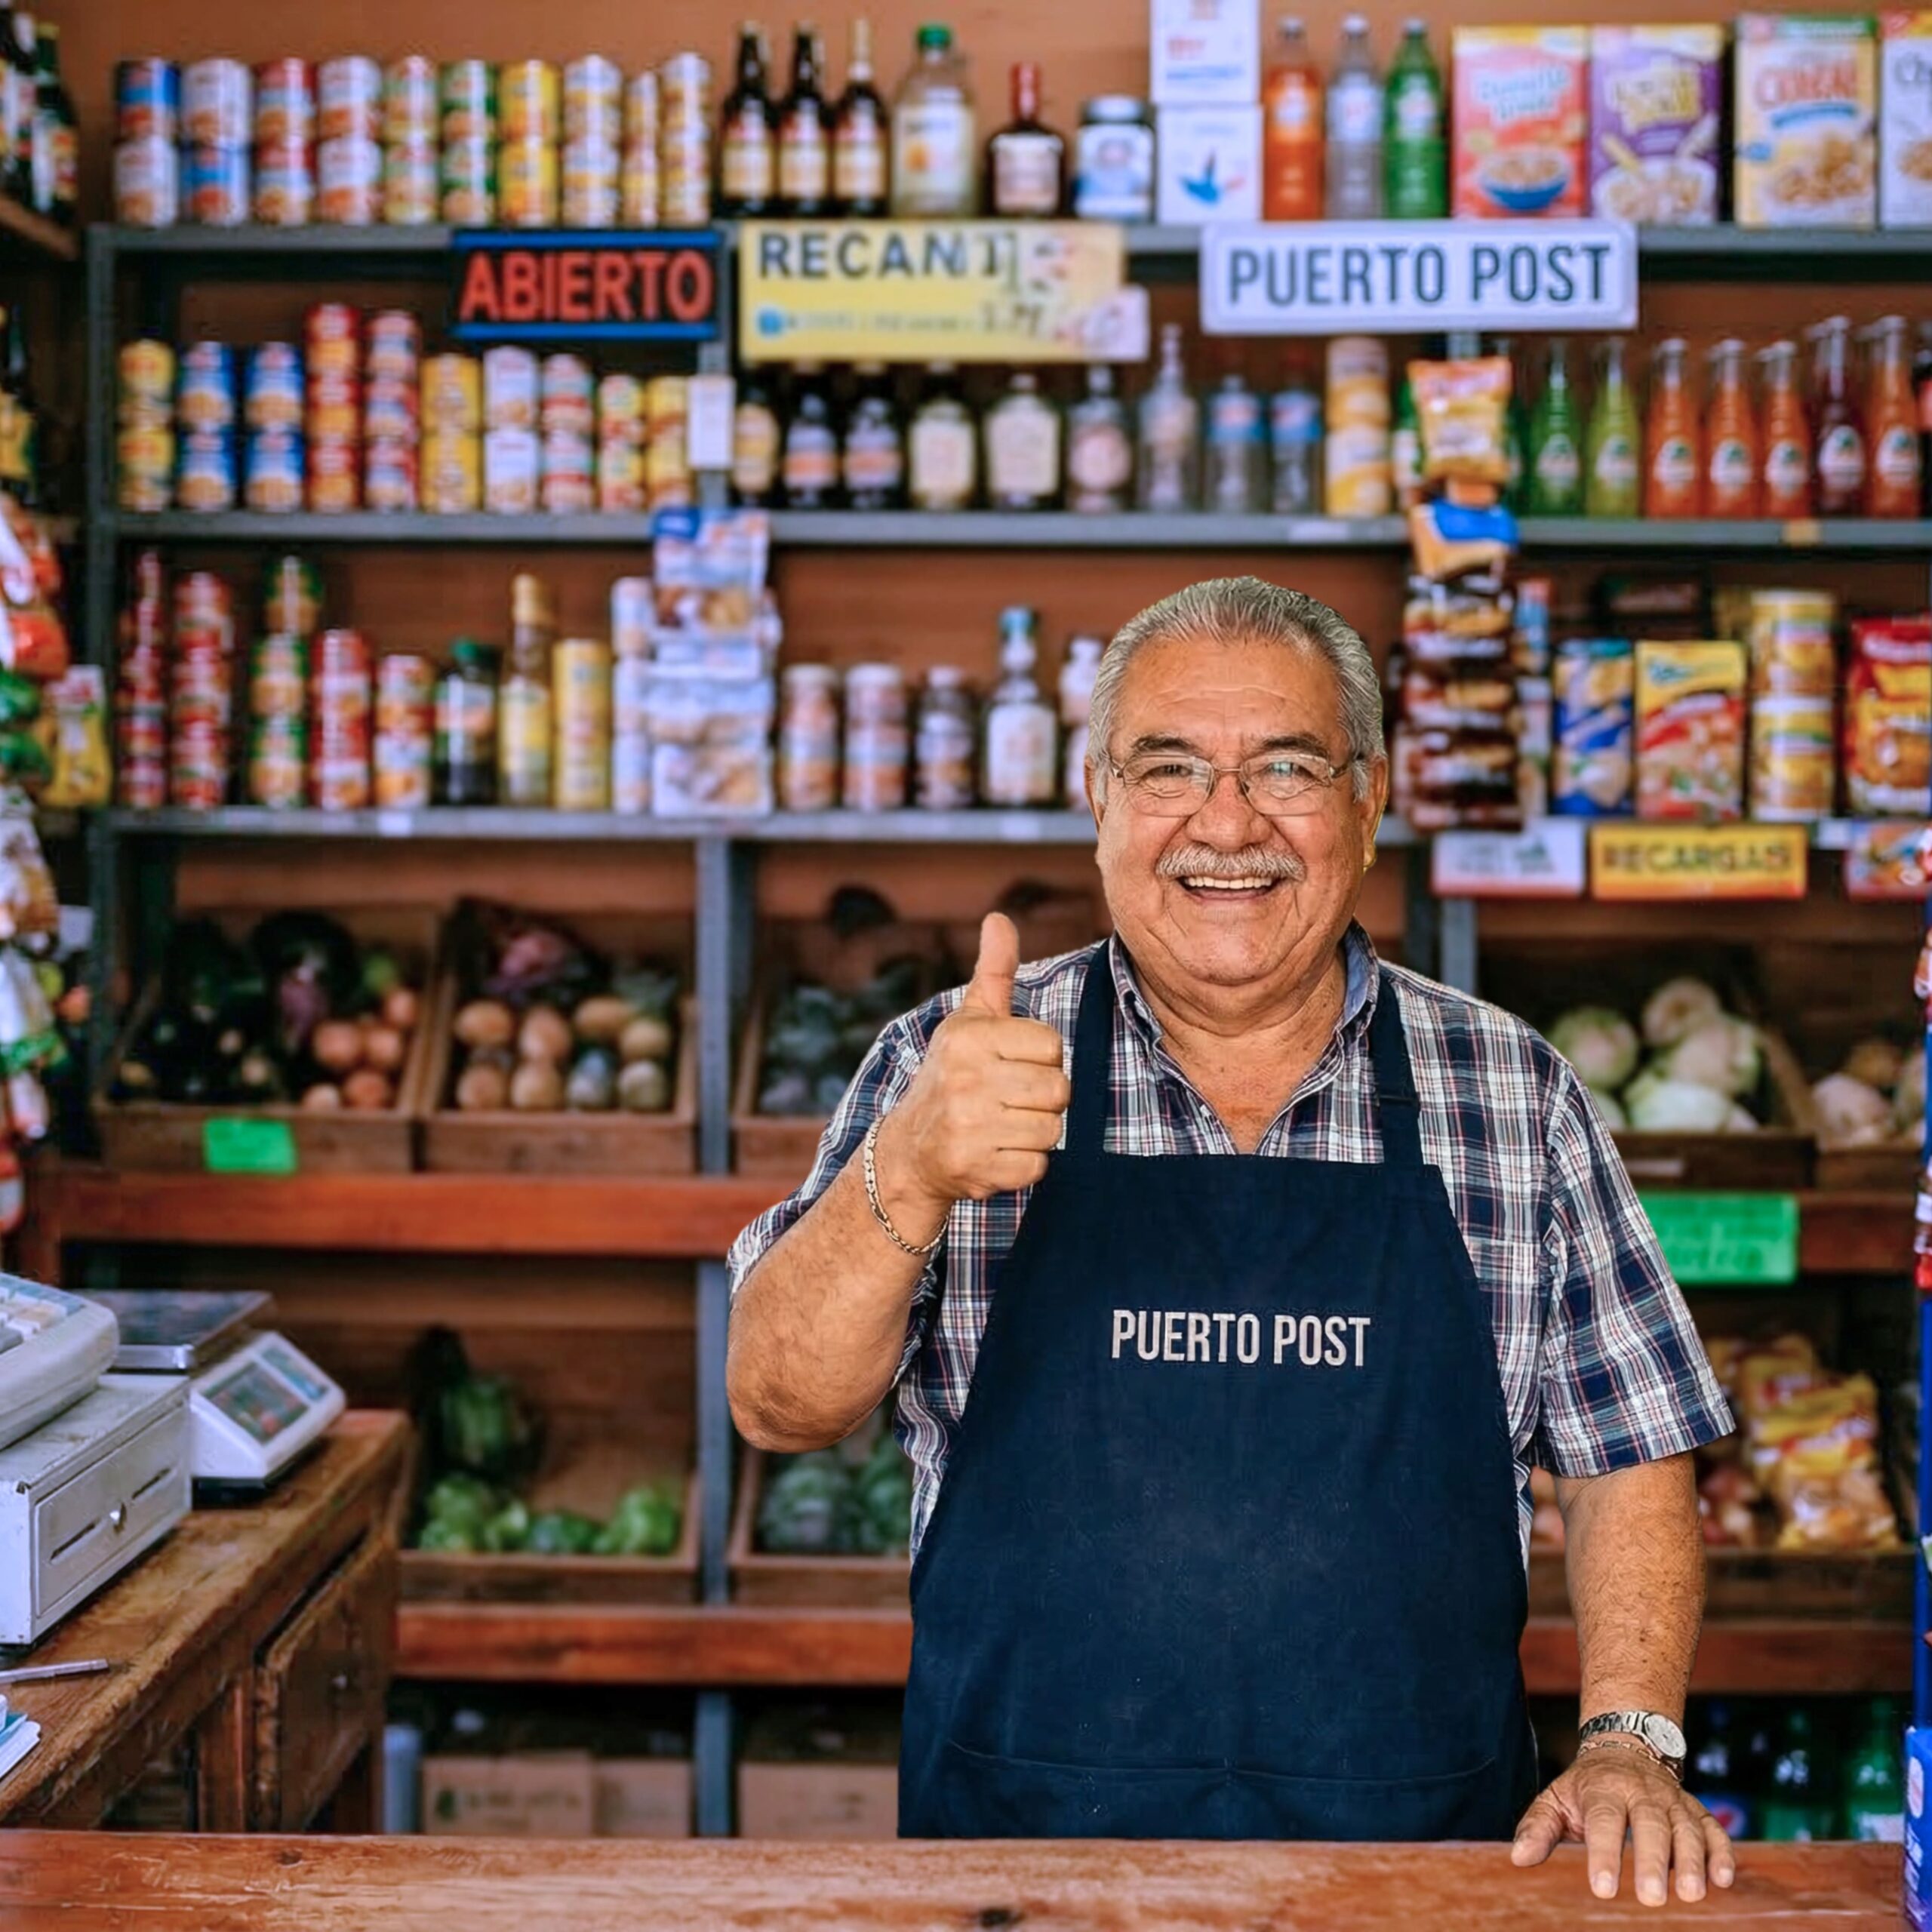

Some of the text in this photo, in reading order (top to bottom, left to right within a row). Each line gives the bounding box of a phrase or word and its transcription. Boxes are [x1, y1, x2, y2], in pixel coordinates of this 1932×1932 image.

[458, 249, 714, 323] ABIERTO
[1229, 243, 1611, 307] PUERTO POST
[1111, 1309, 1371, 1367] PUERTO POST
